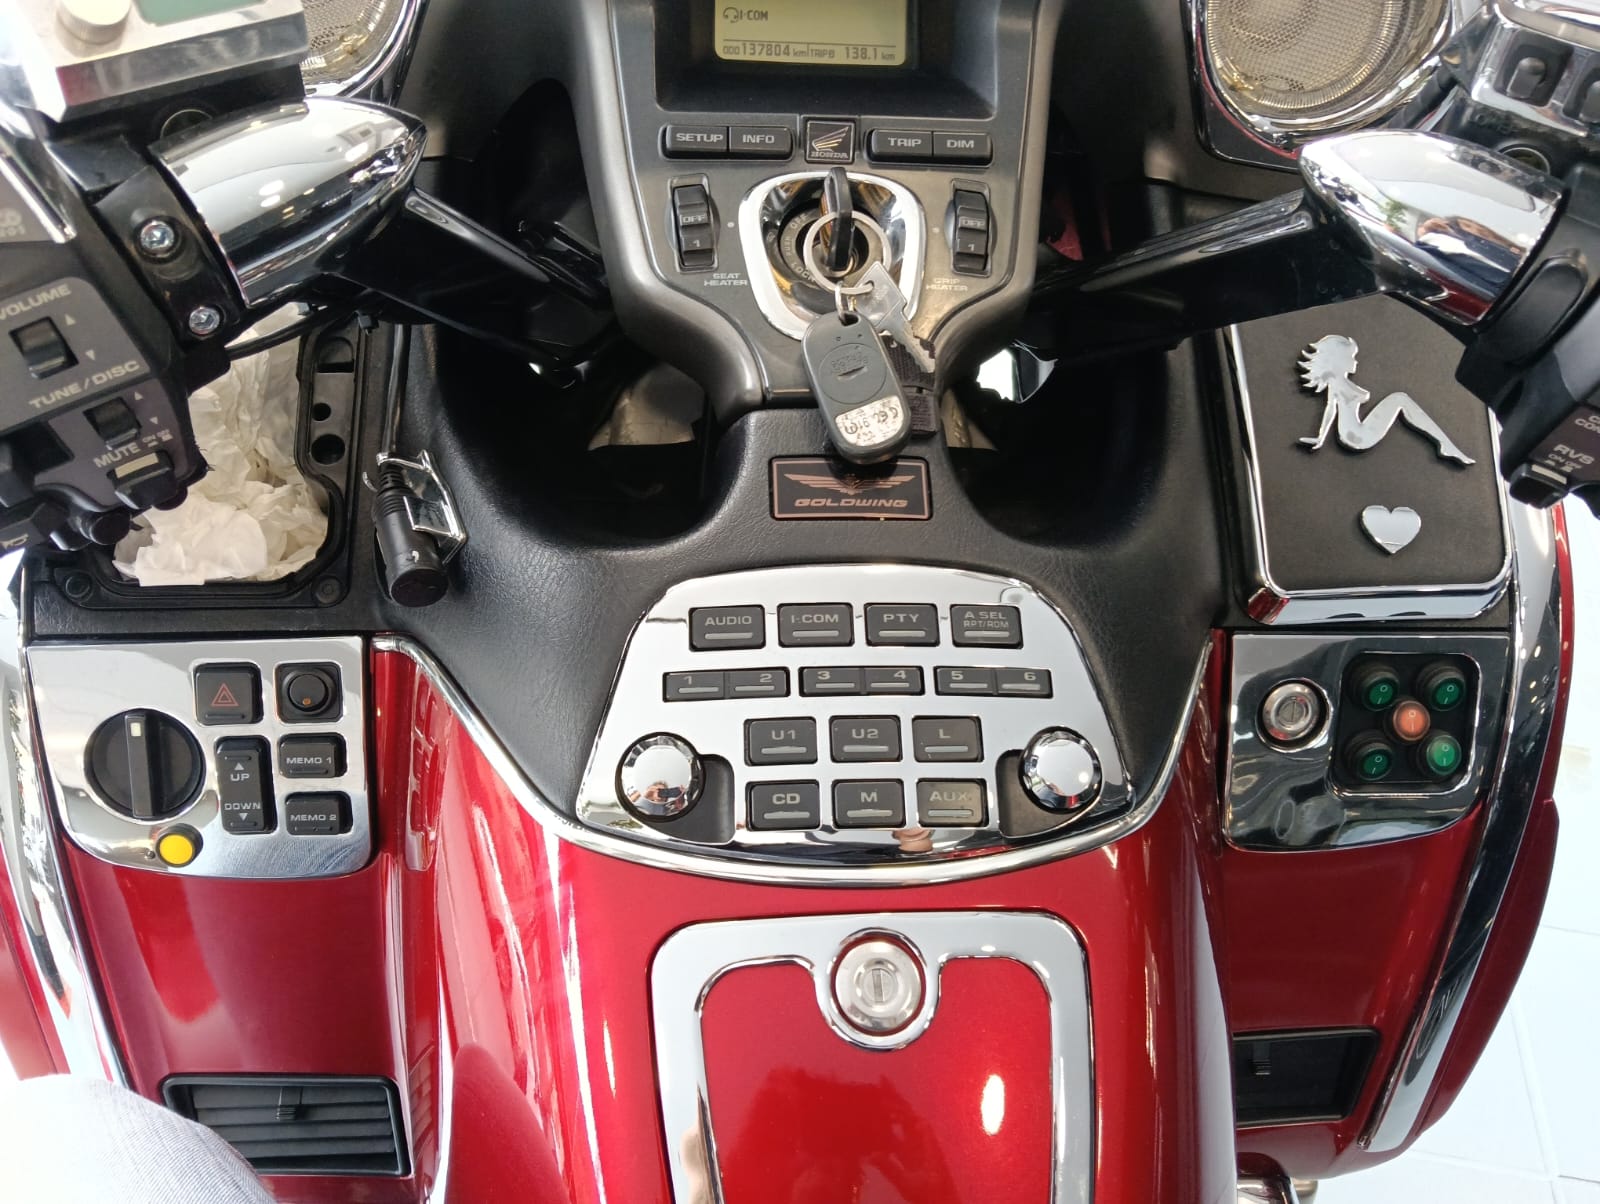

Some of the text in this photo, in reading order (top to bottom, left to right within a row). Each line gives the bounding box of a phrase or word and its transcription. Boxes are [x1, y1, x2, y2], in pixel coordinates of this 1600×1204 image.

[741, 43, 790, 57] 137804
[845, 46, 877, 61] 138.1
[676, 133, 724, 143] SETUP
[742, 134, 775, 145] INFO
[887, 137, 922, 147] TRIP
[946, 139, 975, 150] DIM
[682, 214, 706, 224] OFF
[693, 239, 701, 248] 1
[967, 243, 976, 252] 1
[925, 284, 968, 292] HEATER
[28, 360, 140, 409] TUNE/DISC
[93, 442, 141, 468] MUTE
[1553, 444, 1595, 465] RVS
[794, 498, 908, 508] GOLDWING
[882, 613, 920, 623] PTY
[964, 611, 1008, 620] A SEL
[704, 615, 753, 627] AUDIO
[963, 620, 1010, 629] RPT/RDM
[684, 673, 773, 685] 1 2
[817, 670, 908, 680] 3 4
[951, 670, 1037, 681] 5 6
[771, 729, 797, 740] U1
[851, 728, 880, 739] U2
[938, 729, 951, 739] L
[286, 757, 322, 765] MEMO
[230, 773, 250, 782] UP
[772, 793, 801, 805] CD
[860, 791, 878, 802] M
[929, 790, 968, 802] AUX
[224, 802, 261, 811] DOWN
[290, 814, 325, 822] MEMO
